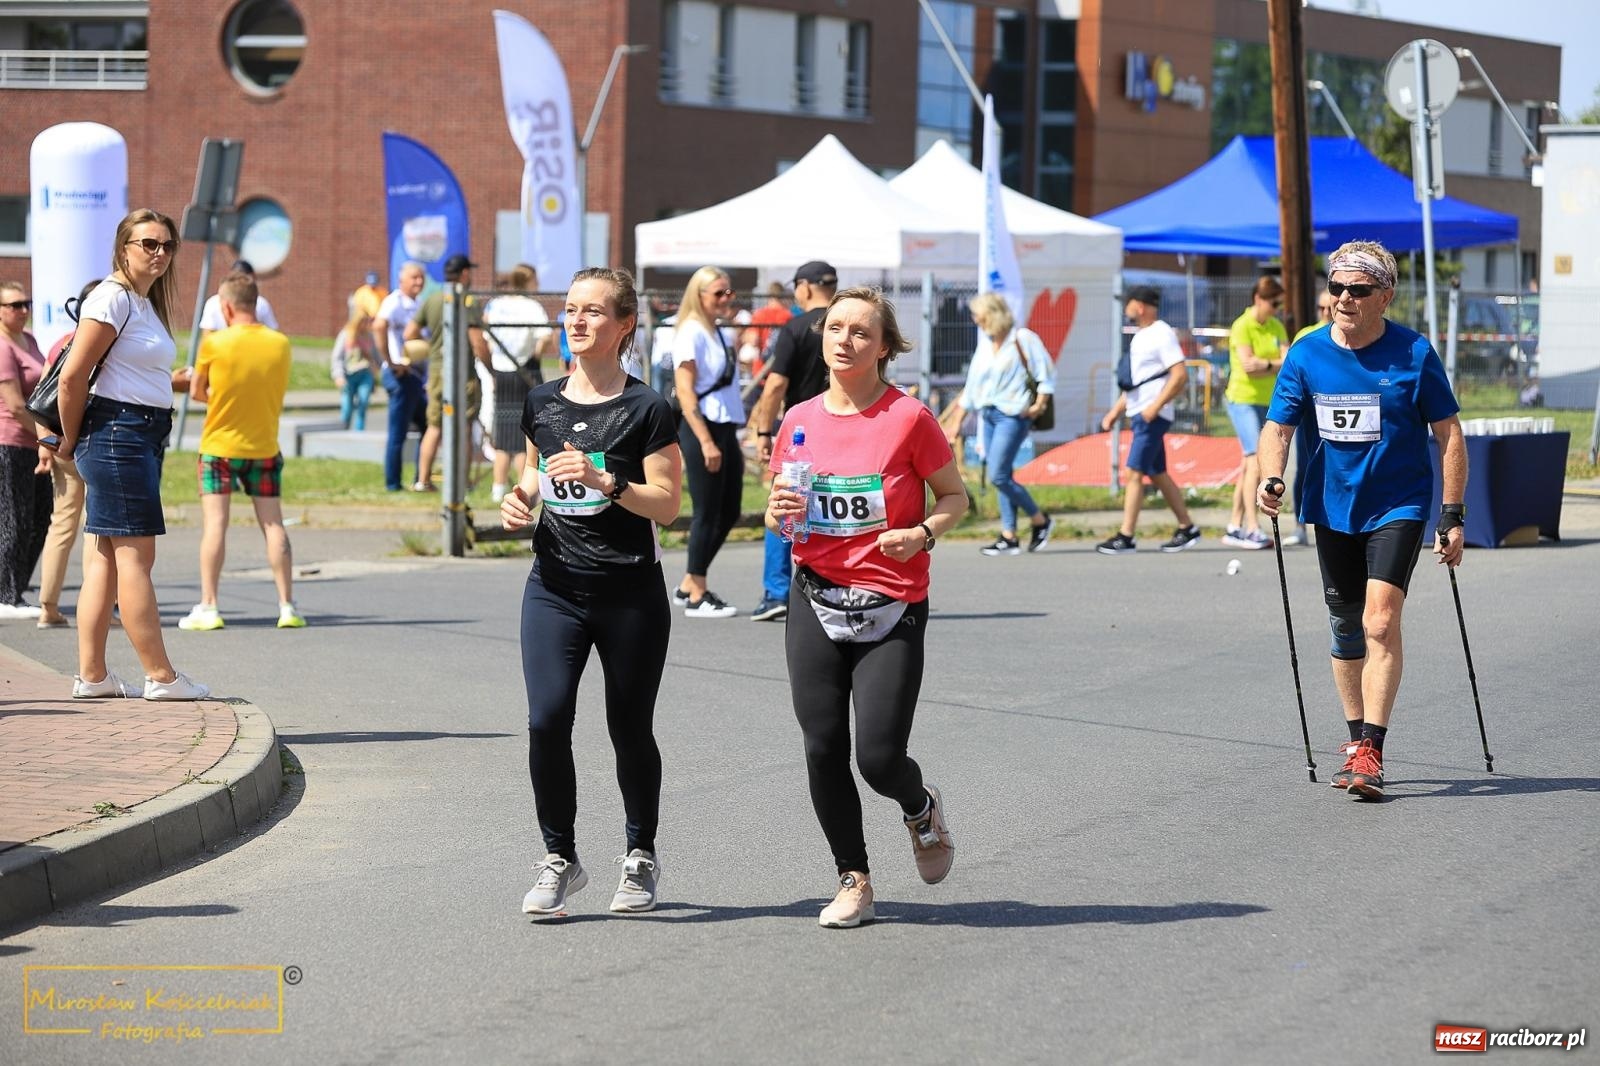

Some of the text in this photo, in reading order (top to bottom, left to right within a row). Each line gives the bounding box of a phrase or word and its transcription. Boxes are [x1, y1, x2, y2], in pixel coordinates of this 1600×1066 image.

[1333, 410, 1361, 428] 57
[551, 477, 587, 500] 86
[847, 477, 871, 485] GRANIC
[818, 495, 870, 520] 108
